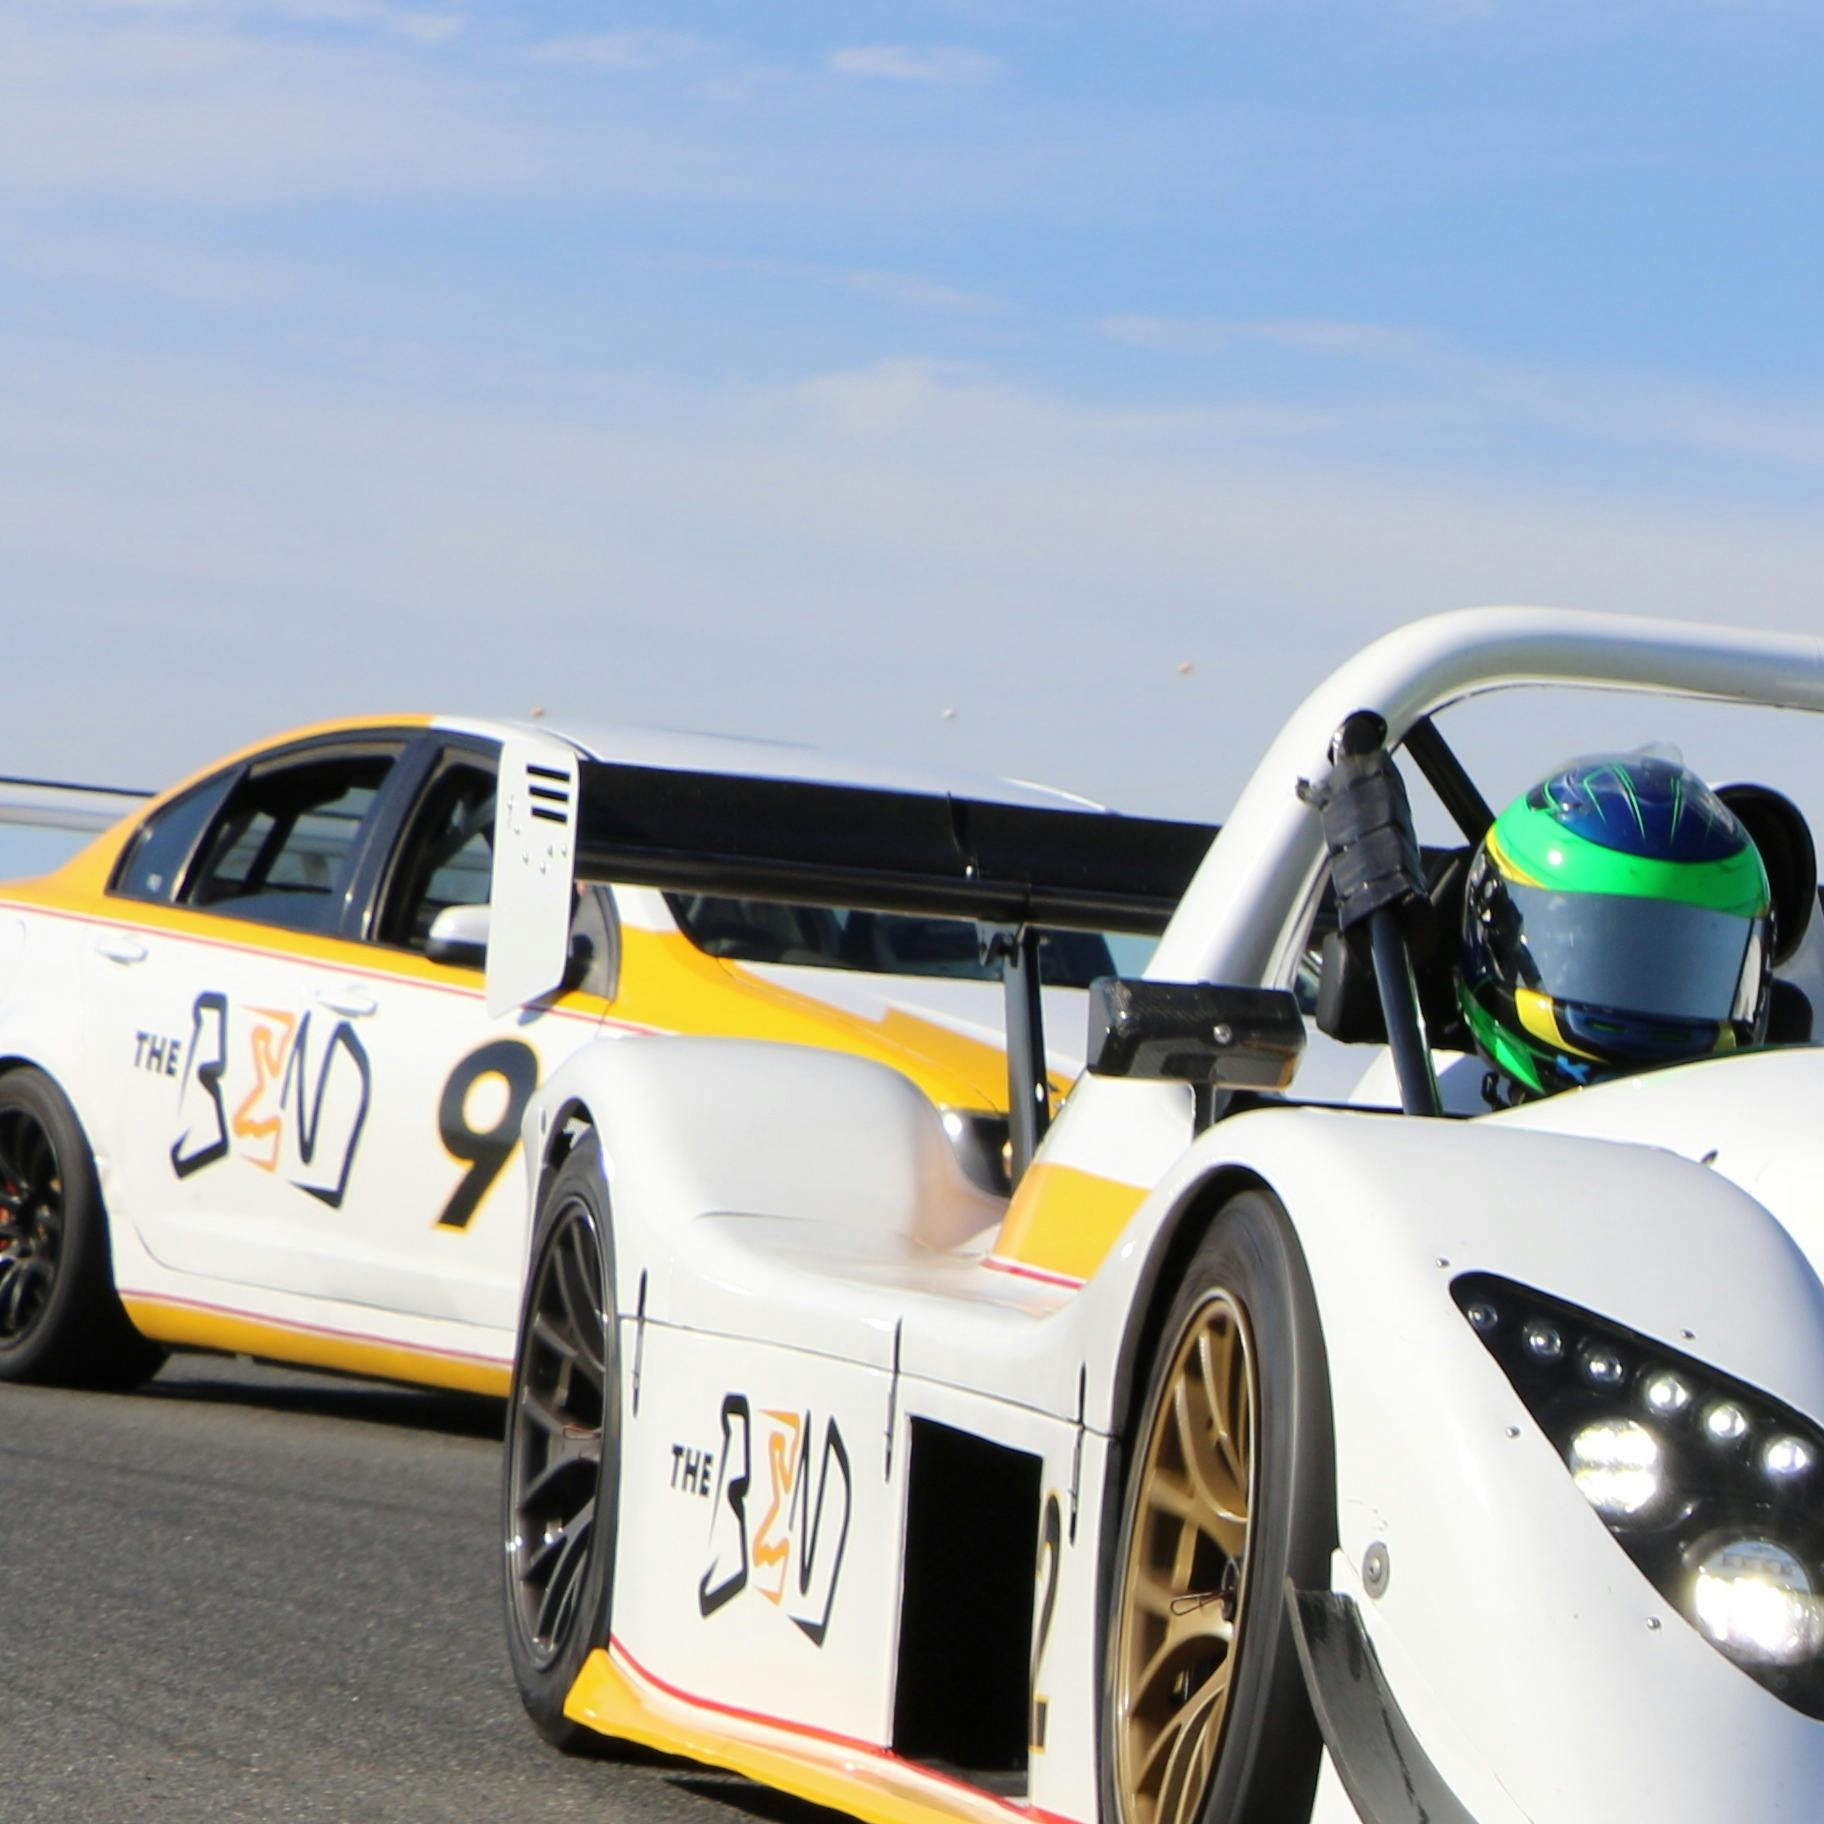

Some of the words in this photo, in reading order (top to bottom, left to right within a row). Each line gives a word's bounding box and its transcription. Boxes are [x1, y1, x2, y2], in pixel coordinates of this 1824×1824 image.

[132, 1031, 181, 1077] THE
[432, 1038, 539, 1234] 9
[670, 1443, 714, 1498] THE
